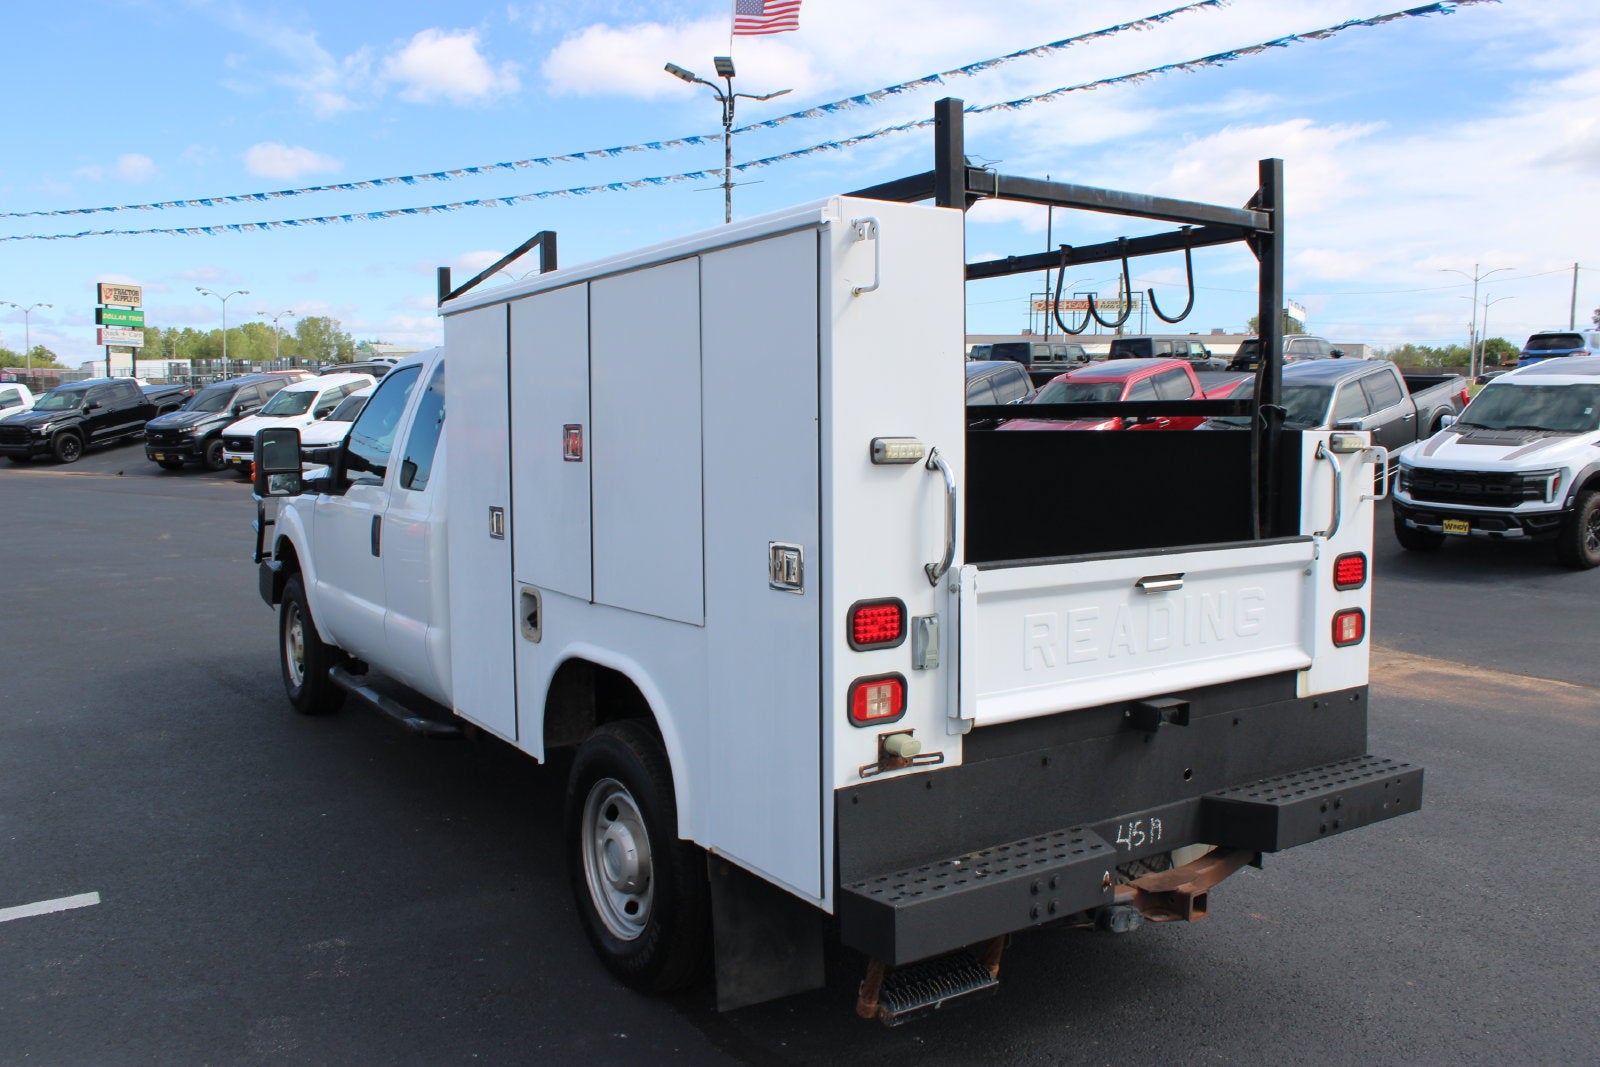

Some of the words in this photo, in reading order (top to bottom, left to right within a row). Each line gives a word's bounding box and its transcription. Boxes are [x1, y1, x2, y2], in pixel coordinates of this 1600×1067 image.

[113, 288, 140, 296] TRACTOR
[102, 313, 127, 321] DOLLAR
[1413, 479, 1513, 494] FORD
[1023, 586, 1267, 672] READING
